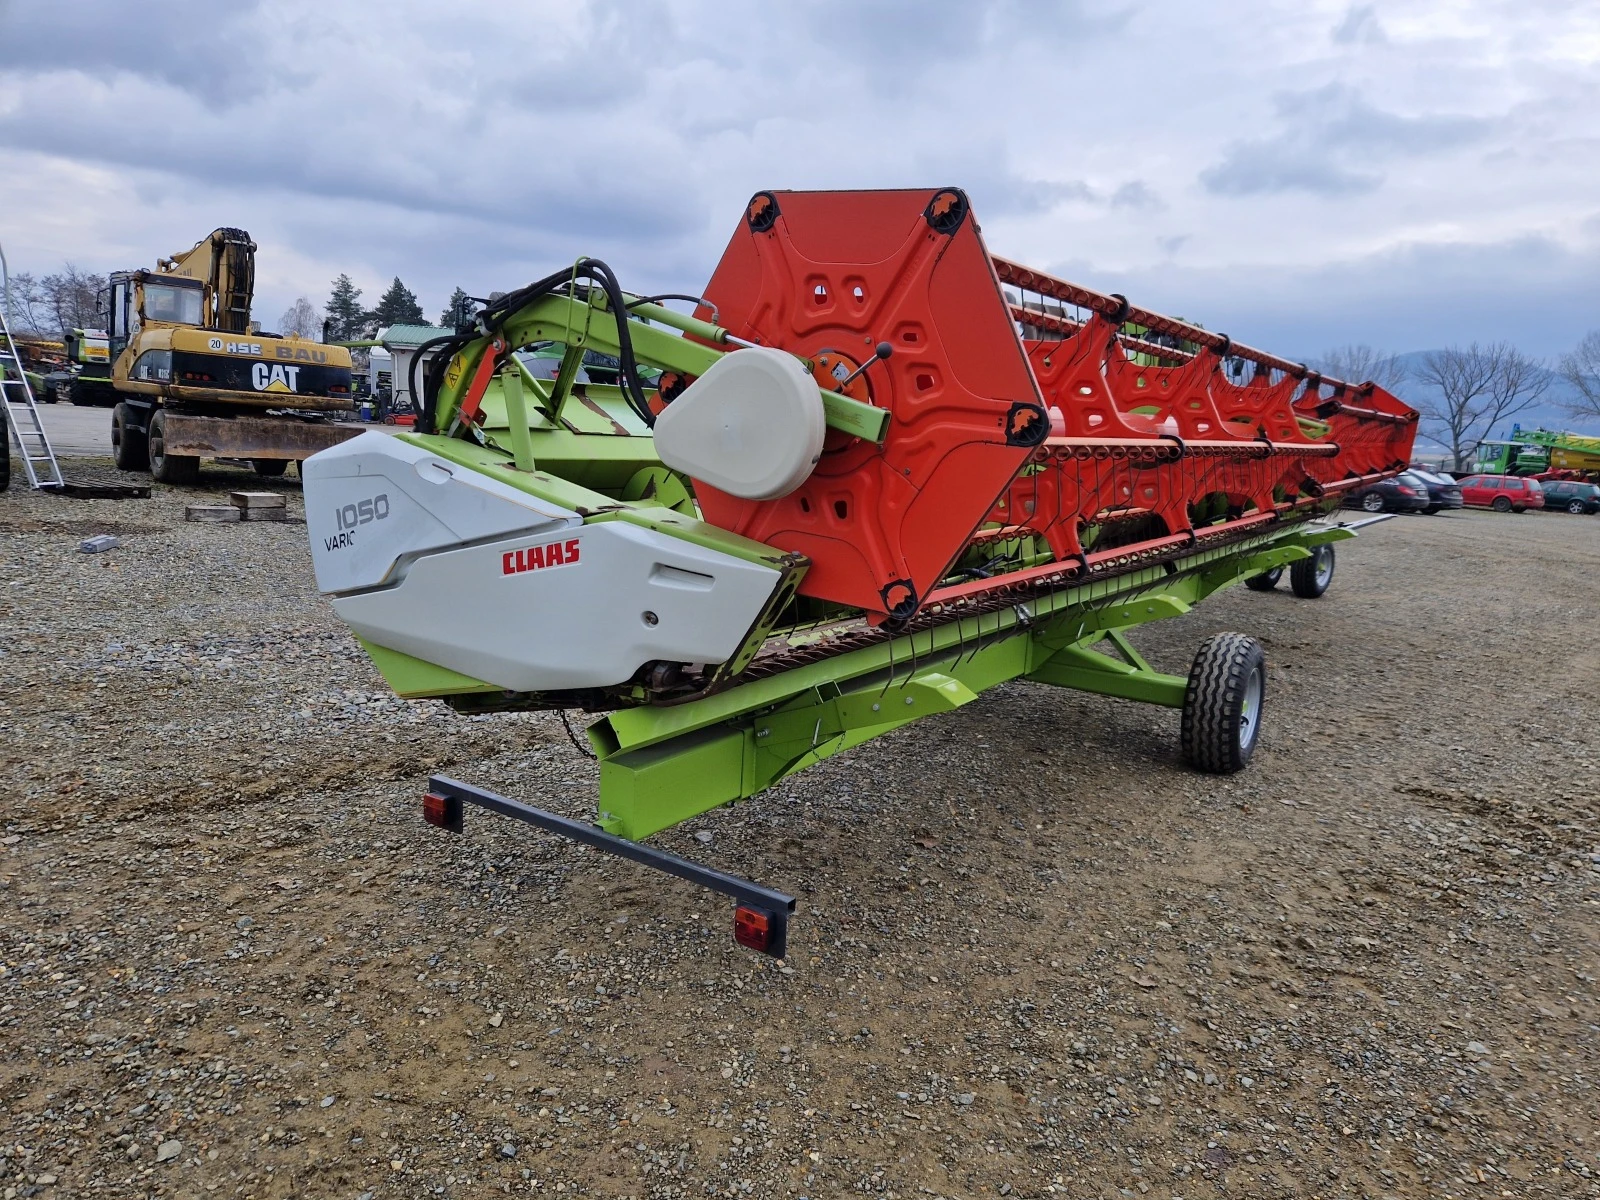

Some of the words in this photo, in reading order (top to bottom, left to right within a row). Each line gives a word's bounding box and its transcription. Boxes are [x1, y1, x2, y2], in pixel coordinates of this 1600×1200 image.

[211, 340, 221, 348] 20
[226, 342, 263, 356] HSE
[275, 346, 326, 363] BAU
[252, 362, 300, 393] CAT
[336, 494, 389, 531] 1050
[502, 539, 580, 575] CLAAS
